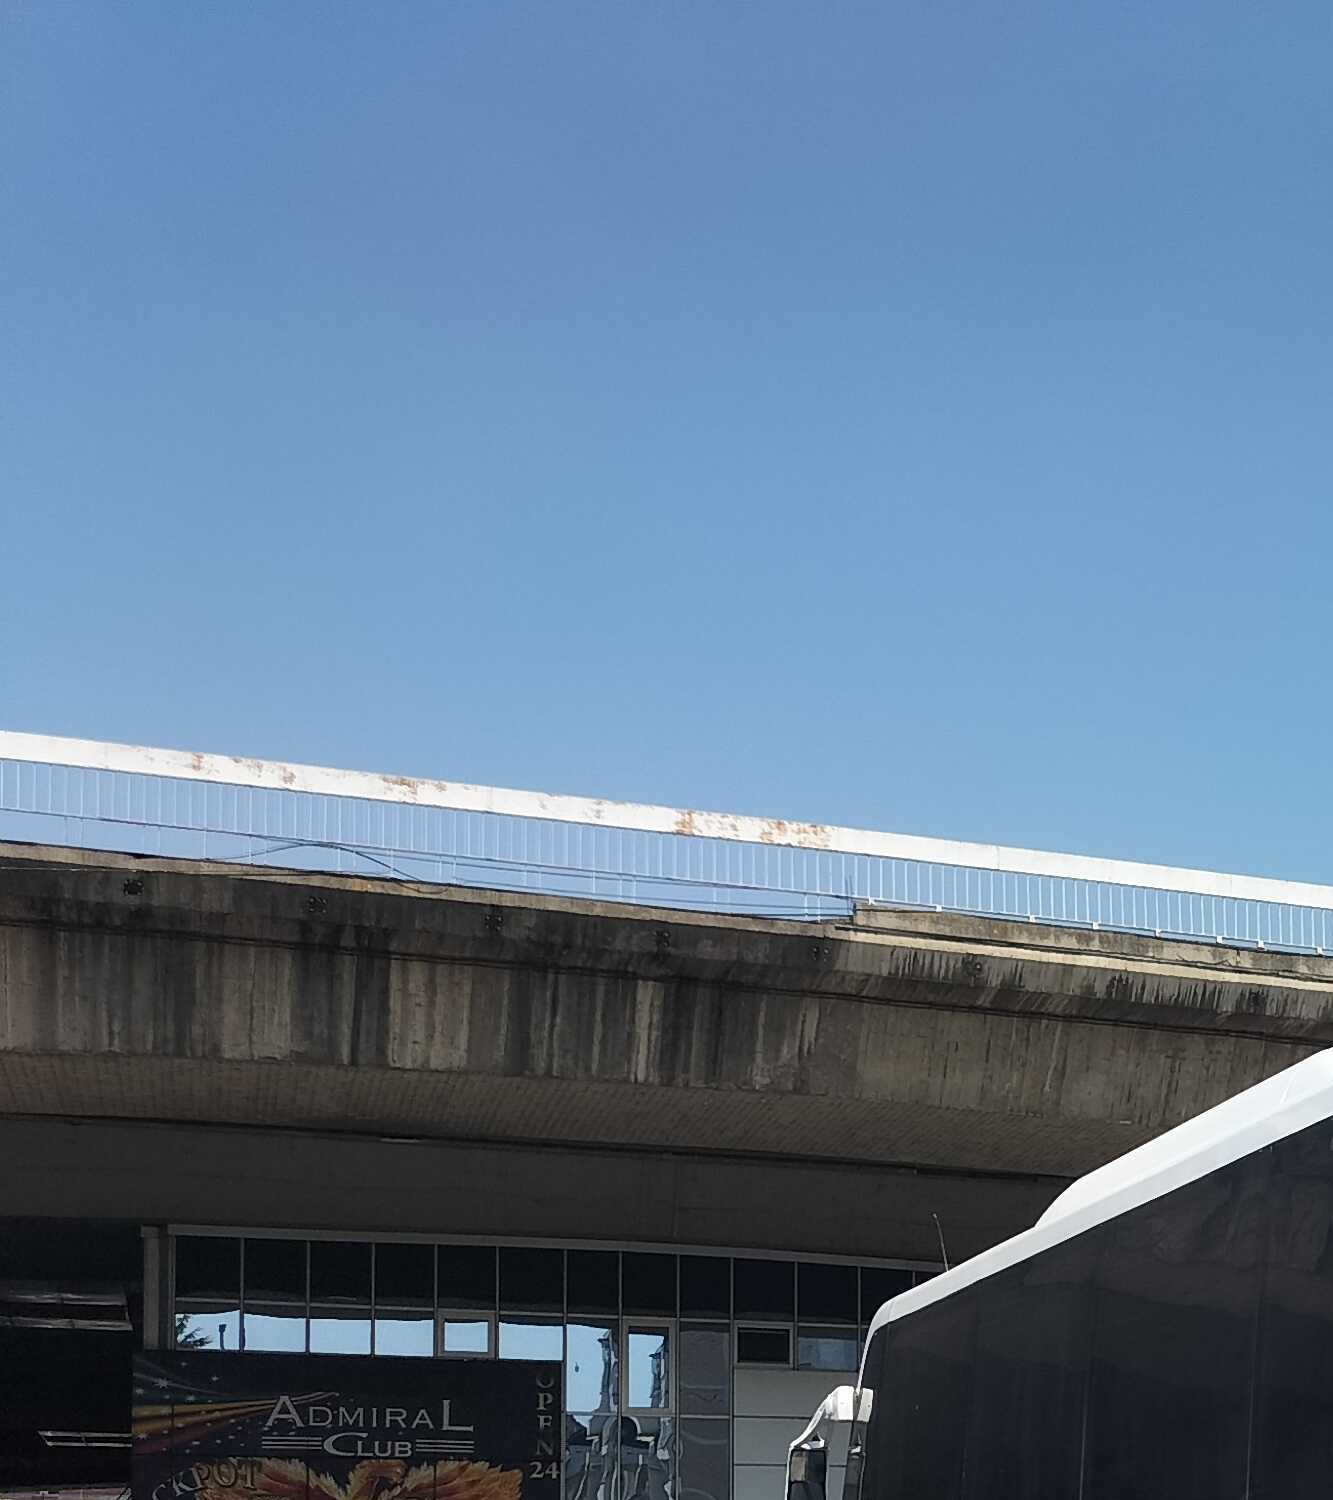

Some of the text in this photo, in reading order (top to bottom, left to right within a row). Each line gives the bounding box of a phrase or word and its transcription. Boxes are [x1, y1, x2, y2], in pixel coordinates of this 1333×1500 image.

[265, 1395, 474, 1432] ADMIRAL
[323, 1432, 413, 1457] CLUB
[529, 1461, 560, 1479] 24
